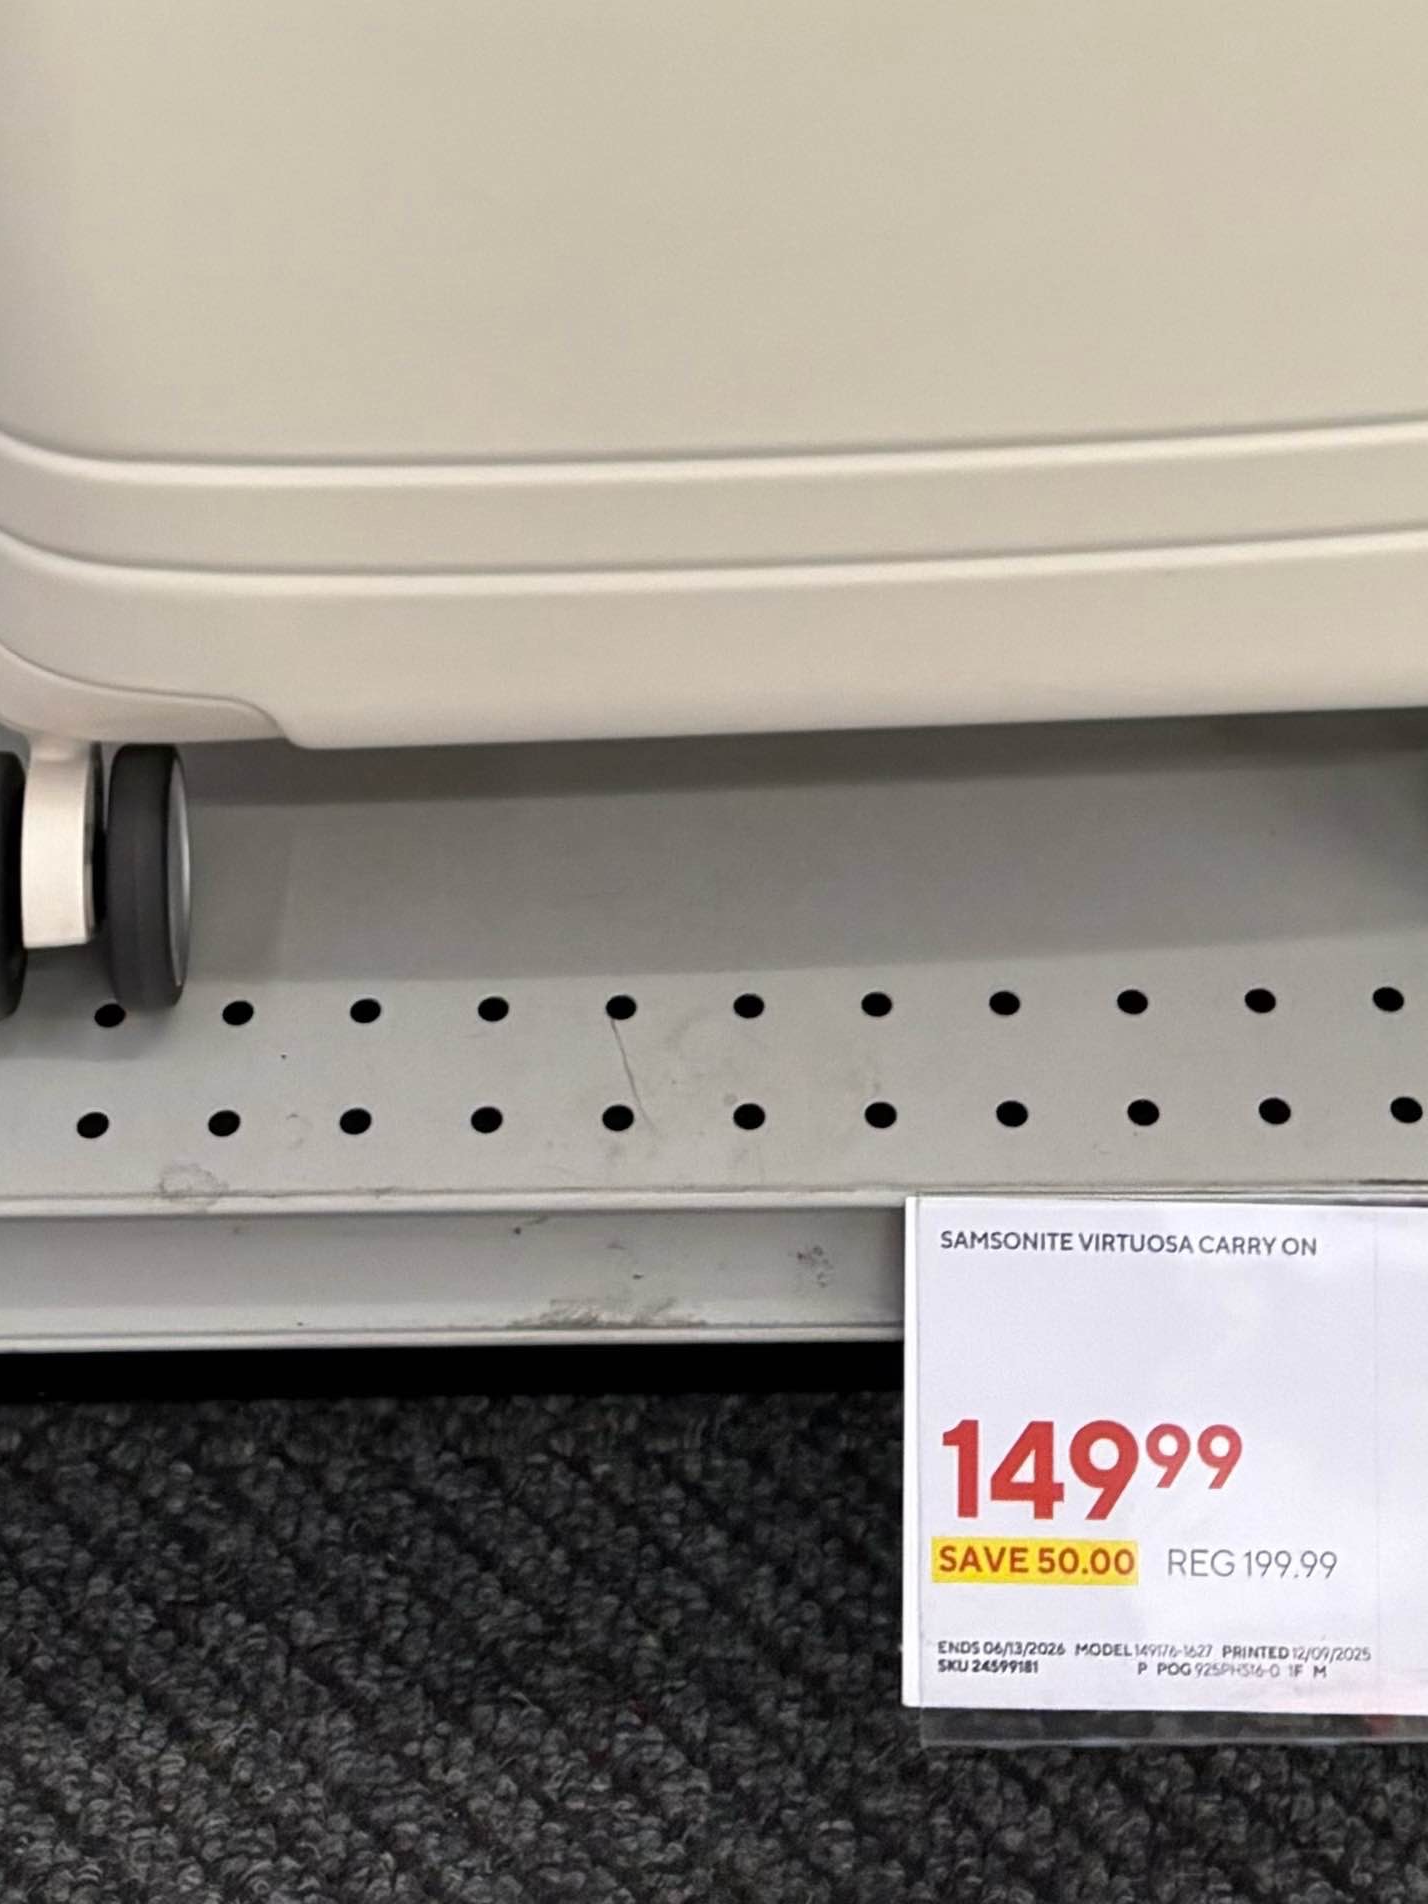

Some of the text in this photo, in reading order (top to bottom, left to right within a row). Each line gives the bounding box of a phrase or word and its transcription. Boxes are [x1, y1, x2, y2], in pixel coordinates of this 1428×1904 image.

[940, 1230, 1317, 1256] SAMSONITE VIRTUOSA CARRY ON
[938, 1545, 1135, 1575] SAVE 50.00
[1167, 1548, 1338, 1580] REG 199.99
[937, 1641, 980, 1655] ENDS
[983, 1641, 1066, 1657] 06/13/2026
[1074, 1643, 1132, 1656] MODEL
[1222, 1645, 1289, 1660] PRINTED
[1291, 1646, 1372, 1663] 12/09/2025
[937, 1658, 968, 1673] SKU
[972, 1659, 1039, 1673] 24599181
[1157, 1662, 1192, 1676] POG
